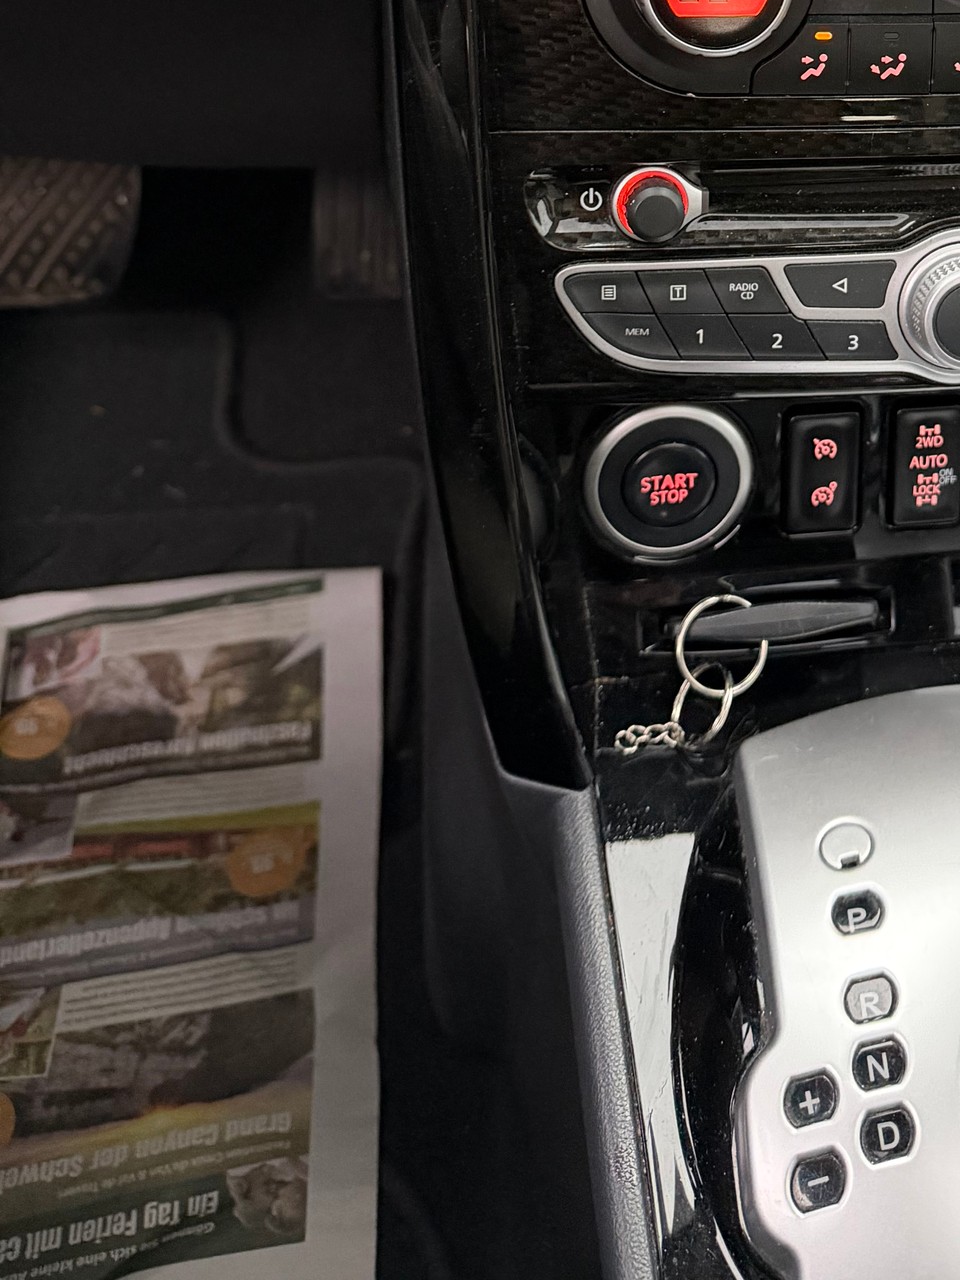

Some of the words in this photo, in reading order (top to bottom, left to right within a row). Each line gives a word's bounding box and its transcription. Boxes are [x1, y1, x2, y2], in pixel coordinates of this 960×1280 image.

[728, 282, 760, 292] RADIO
[740, 291, 755, 301] CD
[625, 327, 650, 337] MEM
[696, 328, 704, 345] 1
[771, 332, 783, 349] 2
[847, 334, 860, 351] 3
[915, 435, 944, 449] 2WD
[909, 453, 948, 470] AUTO
[939, 467, 954, 477] ON
[939, 475, 957, 486] OFF
[640, 472, 699, 494] START
[912, 484, 941, 497] LOCK
[649, 488, 689, 507] STOP
[846, 906, 867, 933] P
[859, 991, 882, 1018] R
[866, 1051, 890, 1083] N
[876, 1120, 901, 1152] D
[187, 1190, 219, 1217] Ein
[143, 1199, 181, 1229] Tag
[68, 1208, 138, 1245] Ferien
[25, 1225, 63, 1259] mit
